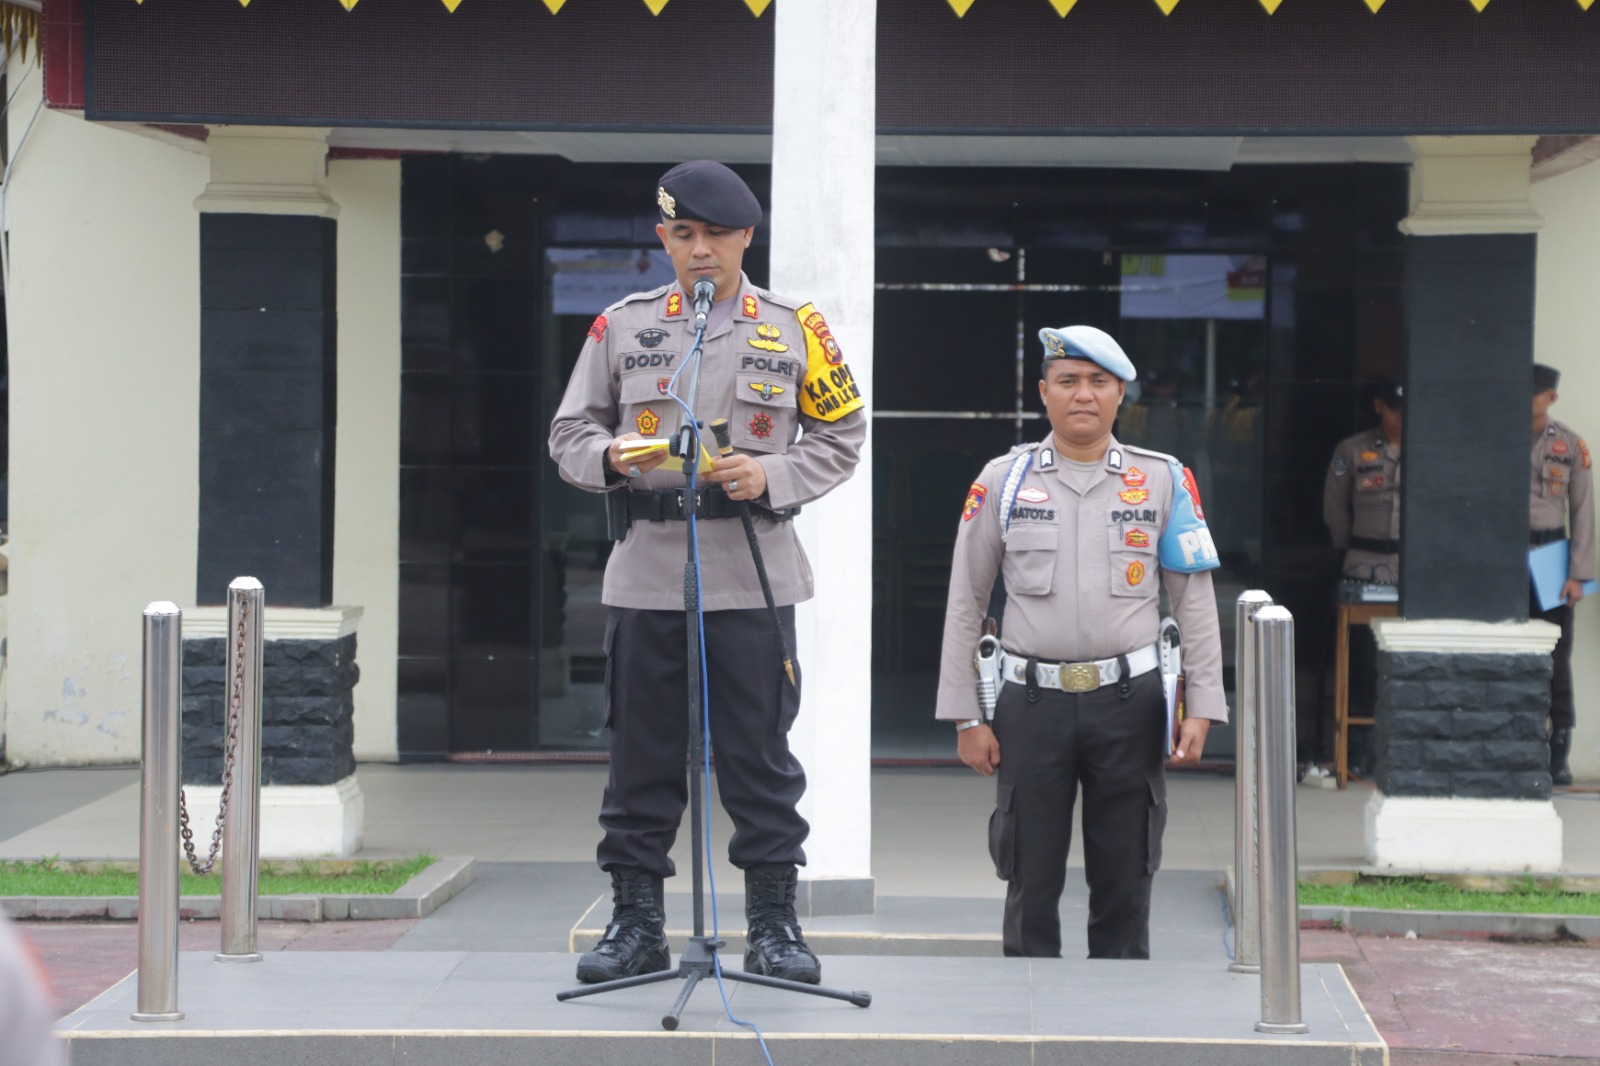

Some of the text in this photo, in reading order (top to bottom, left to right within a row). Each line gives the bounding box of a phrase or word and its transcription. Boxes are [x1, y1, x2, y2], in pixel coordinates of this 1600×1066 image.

[624, 353, 675, 370] DODY
[742, 356, 793, 376] POLRI
[805, 378, 832, 403] KA
[816, 394, 840, 416] OMB
[1111, 509, 1156, 523] POLRI
